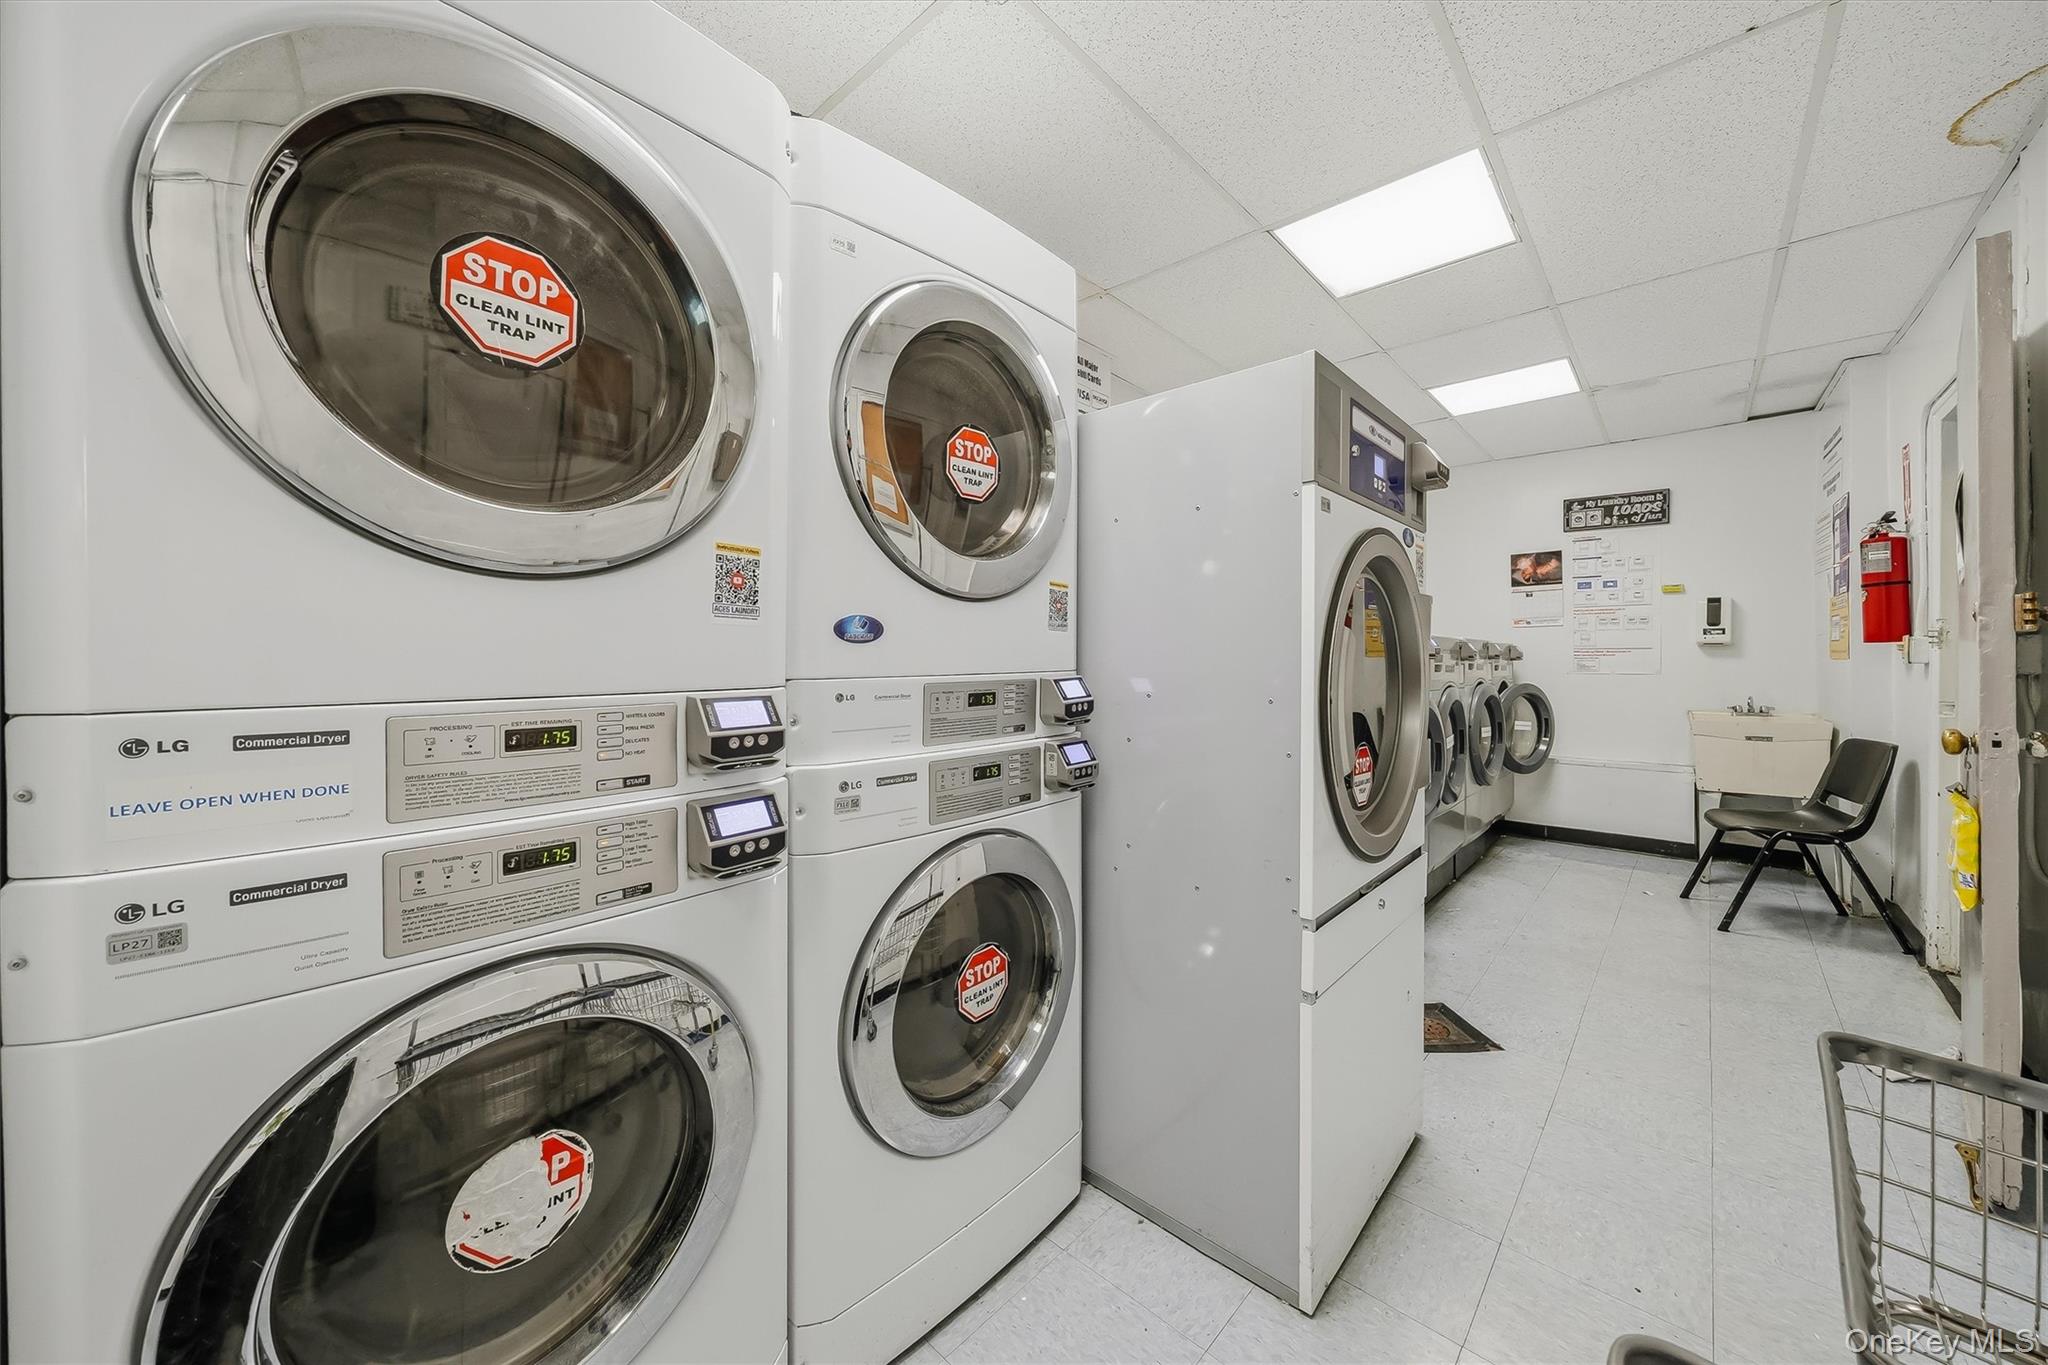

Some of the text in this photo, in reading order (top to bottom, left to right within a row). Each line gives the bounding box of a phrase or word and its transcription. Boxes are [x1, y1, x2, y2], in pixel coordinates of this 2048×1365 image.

[462, 252, 560, 305] STOP
[455, 293, 565, 336] CLEAN LINT
[487, 319, 536, 343] TRAP
[954, 438, 992, 463] STOP
[952, 464, 994, 480] CLEAN LINT
[964, 477, 982, 487] TRAP
[1613, 501, 1663, 516] LOADS
[1631, 513, 1662, 523] of fun
[430, 724, 473, 732] PROCESSING
[236, 733, 347, 749] Commercial Dryer
[543, 730, 570, 745] 1.75
[157, 739, 189, 754] LG
[626, 777, 647, 785] START
[851, 781, 862, 790] LG
[110, 783, 350, 818] LEAVE OPEN WHEN DONE
[543, 847, 570, 864] 1.75
[232, 877, 345, 903] Commercial Dryer
[152, 899, 185, 917] LG
[112, 938, 149, 953] LP27
[965, 955, 1000, 987] STOP
[964, 978, 1004, 1004] CLEAN LINT
[976, 993, 994, 1008] TRAP
[547, 1187, 576, 1208] INT
